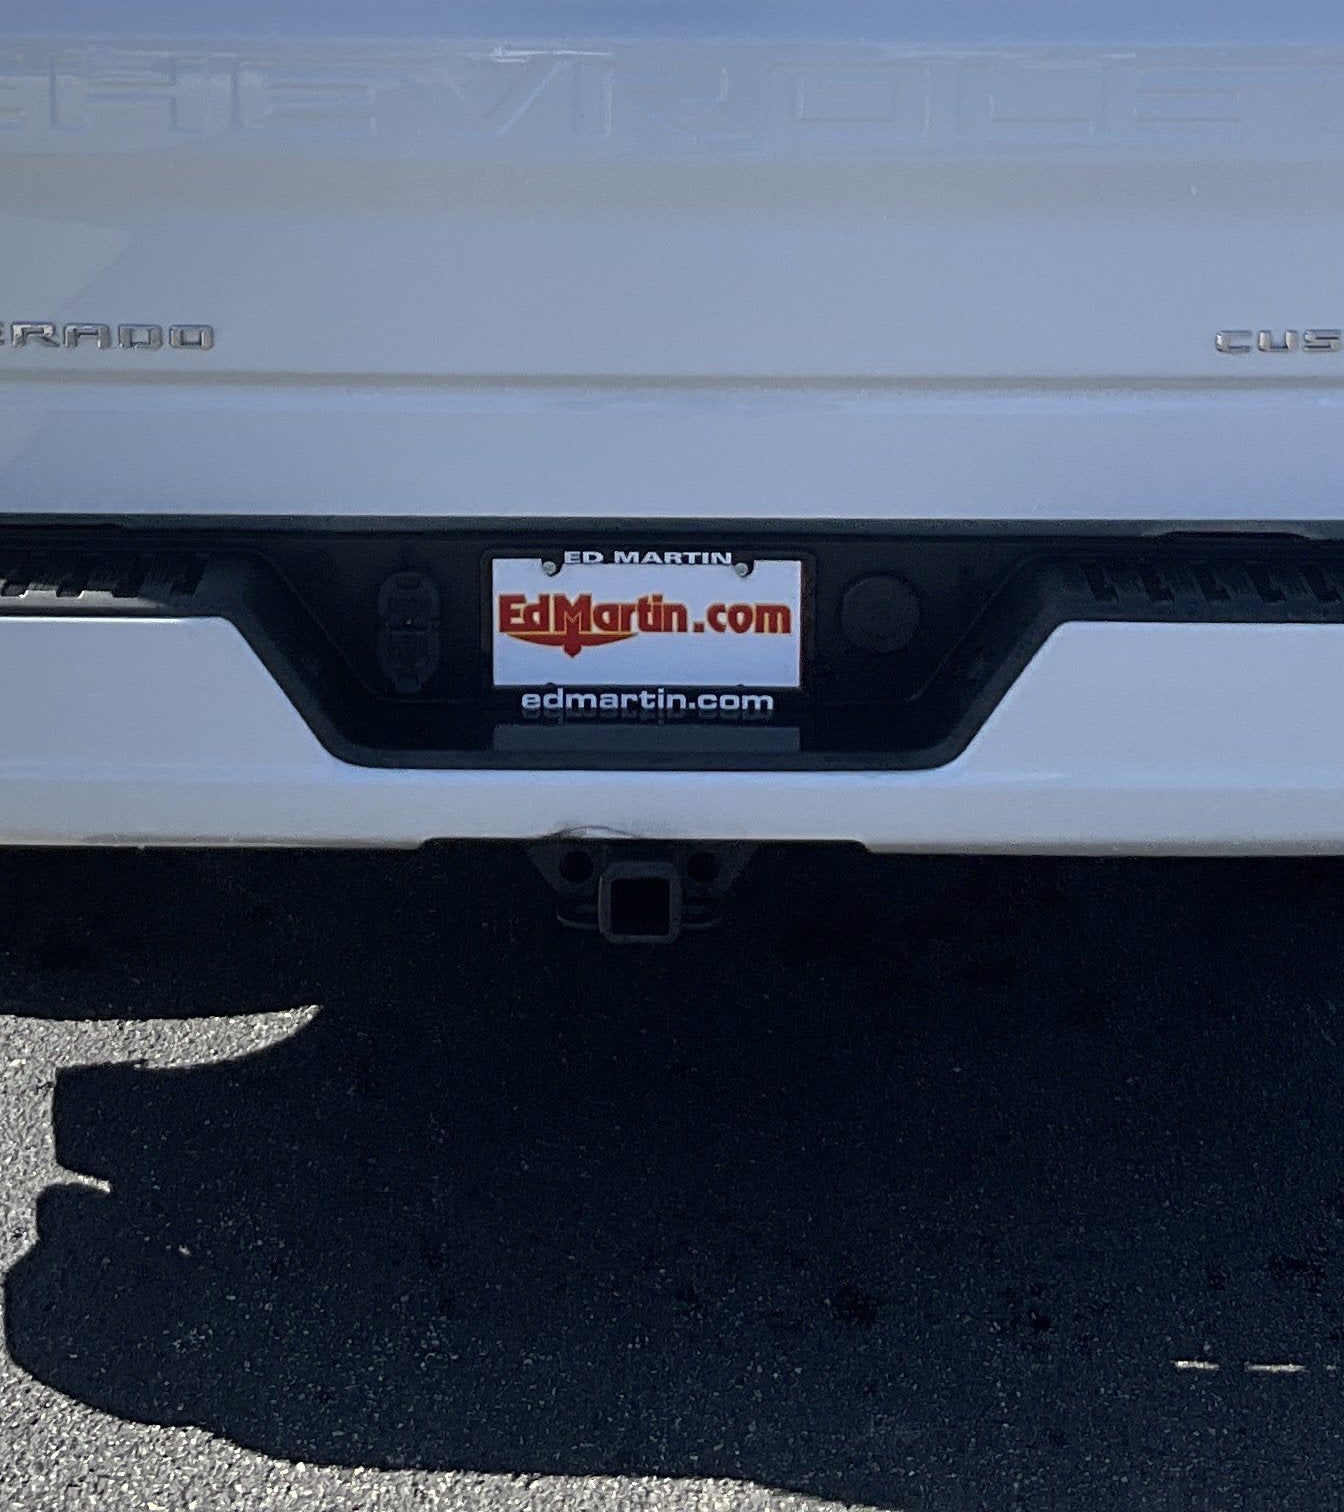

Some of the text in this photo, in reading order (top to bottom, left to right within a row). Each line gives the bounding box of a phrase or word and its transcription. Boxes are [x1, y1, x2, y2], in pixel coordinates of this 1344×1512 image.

[564, 550, 733, 565] ED MARTIN
[498, 592, 792, 635] EdMartin.com
[521, 687, 774, 711] edmartin.com
